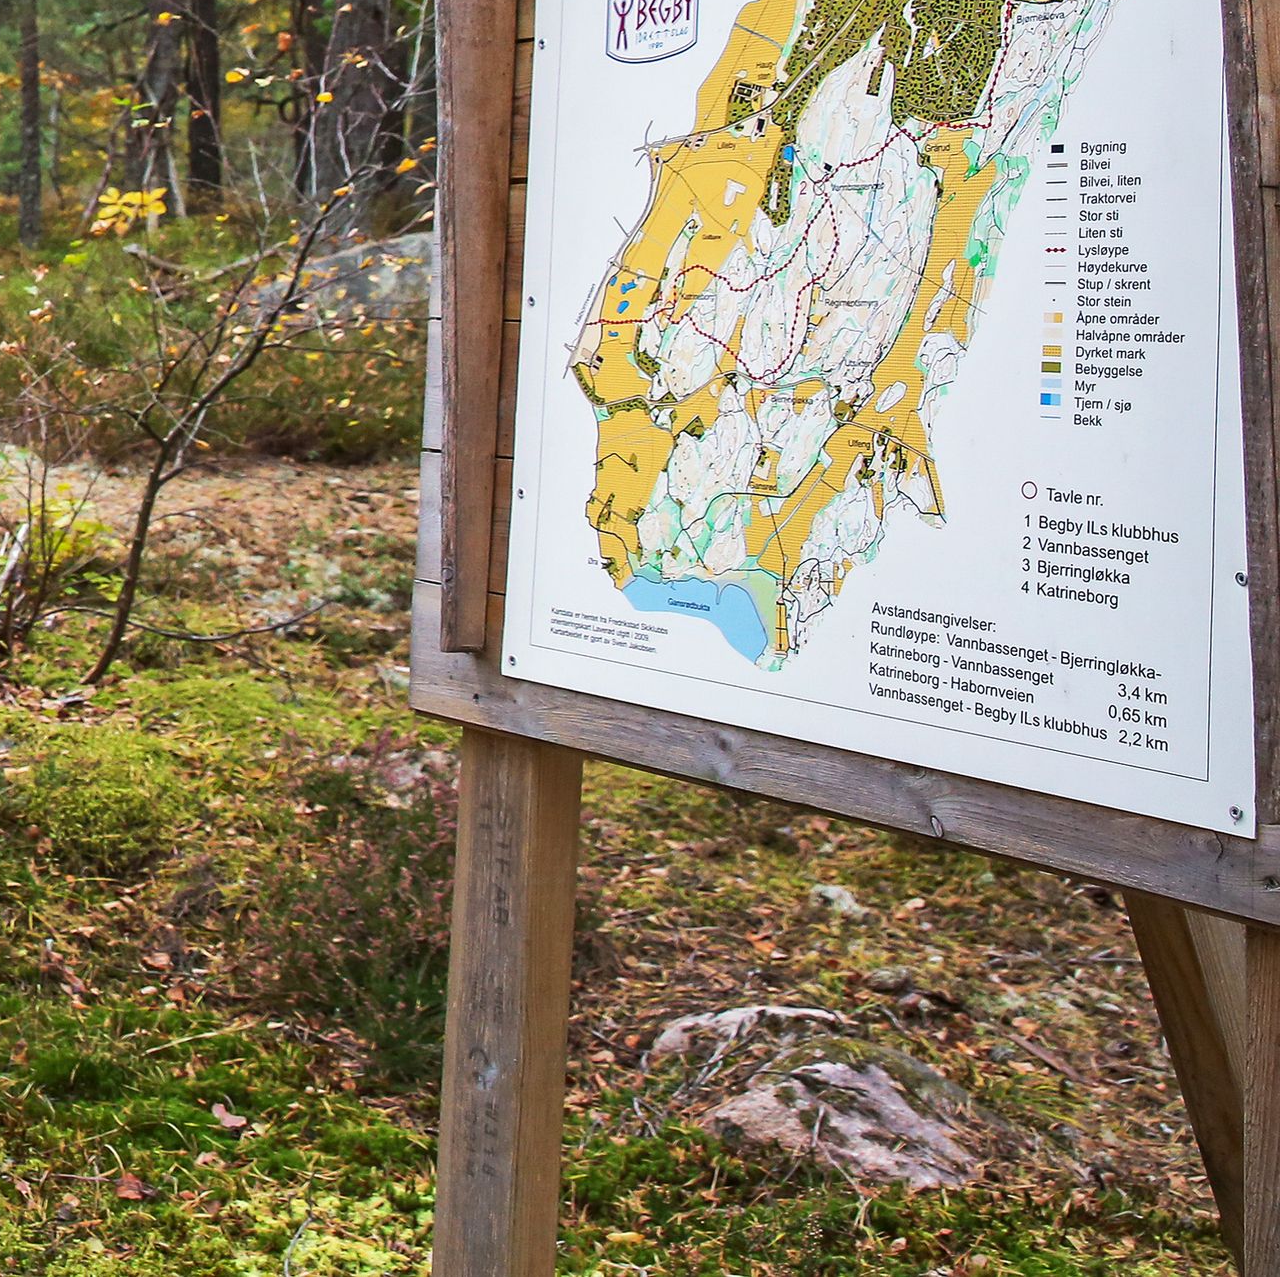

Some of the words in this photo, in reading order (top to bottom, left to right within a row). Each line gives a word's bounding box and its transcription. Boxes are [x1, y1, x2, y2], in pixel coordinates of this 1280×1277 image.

[1080, 141, 1127, 156] Bygning
[1080, 158, 1111, 171] Bilvei
[800, 181, 807, 195] 2
[1079, 176, 1114, 188] Bilvei,
[1117, 175, 1142, 187] liten
[1079, 192, 1137, 205] Traktorvei
[1079, 210, 1103, 222] Stor
[1106, 209, 1120, 221] sti
[1078, 227, 1106, 239] Liten
[1110, 227, 1124, 239] sti
[1078, 244, 1130, 258] Lysløype
[1077, 261, 1148, 275] Høydekurve
[1077, 278, 1104, 292] Stup
[1114, 278, 1151, 290] skrent
[1077, 295, 1101, 307] Stor
[1103, 296, 1132, 308] stein
[1076, 310, 1106, 326] Åpne
[1109, 313, 1160, 326] områder
[1076, 329, 1131, 344] Halvåpne
[1134, 331, 1186, 344] områder
[1075, 346, 1113, 361] Dyrket
[1116, 348, 1146, 360] mark
[1075, 363, 1144, 379] Bebyggelse
[1074, 380, 1097, 395] Myr
[1074, 397, 1103, 411] Tjern
[1114, 400, 1132, 414] sjø
[1073, 414, 1103, 427] Bekk
[1046, 487, 1083, 505] Tavle
[1086, 494, 1104, 507] nr.
[1024, 514, 1031, 528] 1
[1038, 515, 1084, 537] Begby
[1086, 520, 1109, 536] ILs
[1111, 523, 1180, 544] klubbhus
[1022, 536, 1032, 550] 2
[1038, 537, 1150, 566] Vannbassenget
[1022, 558, 1031, 572] 3
[1037, 560, 1131, 585] Bjerringløkka
[1021, 580, 1030, 594] 4
[1036, 582, 1119, 609] Katrineborg
[871, 602, 997, 633] Avstandsangivelser:
[871, 620, 940, 645] Rundløype:
[946, 633, 1049, 664] Vannbassenget
[1060, 651, 1162, 680] Bjerringløkka-
[870, 642, 941, 668] Katrineborg
[951, 655, 1055, 686] Vannbassenget
[1117, 683, 1141, 702] 3,4
[1145, 687, 1168, 705] km
[869, 662, 940, 689] Katrineborg
[951, 676, 1035, 704] Habornveien
[1107, 704, 1141, 724] 0,65
[1145, 711, 1168, 729] km
[869, 682, 964, 714] Vannbassenget
[974, 702, 1017, 728] Begby
[1020, 711, 1040, 727] ILs
[1044, 715, 1108, 741] klubbhus
[1118, 729, 1141, 749] 2,2
[1145, 734, 1169, 752] km
